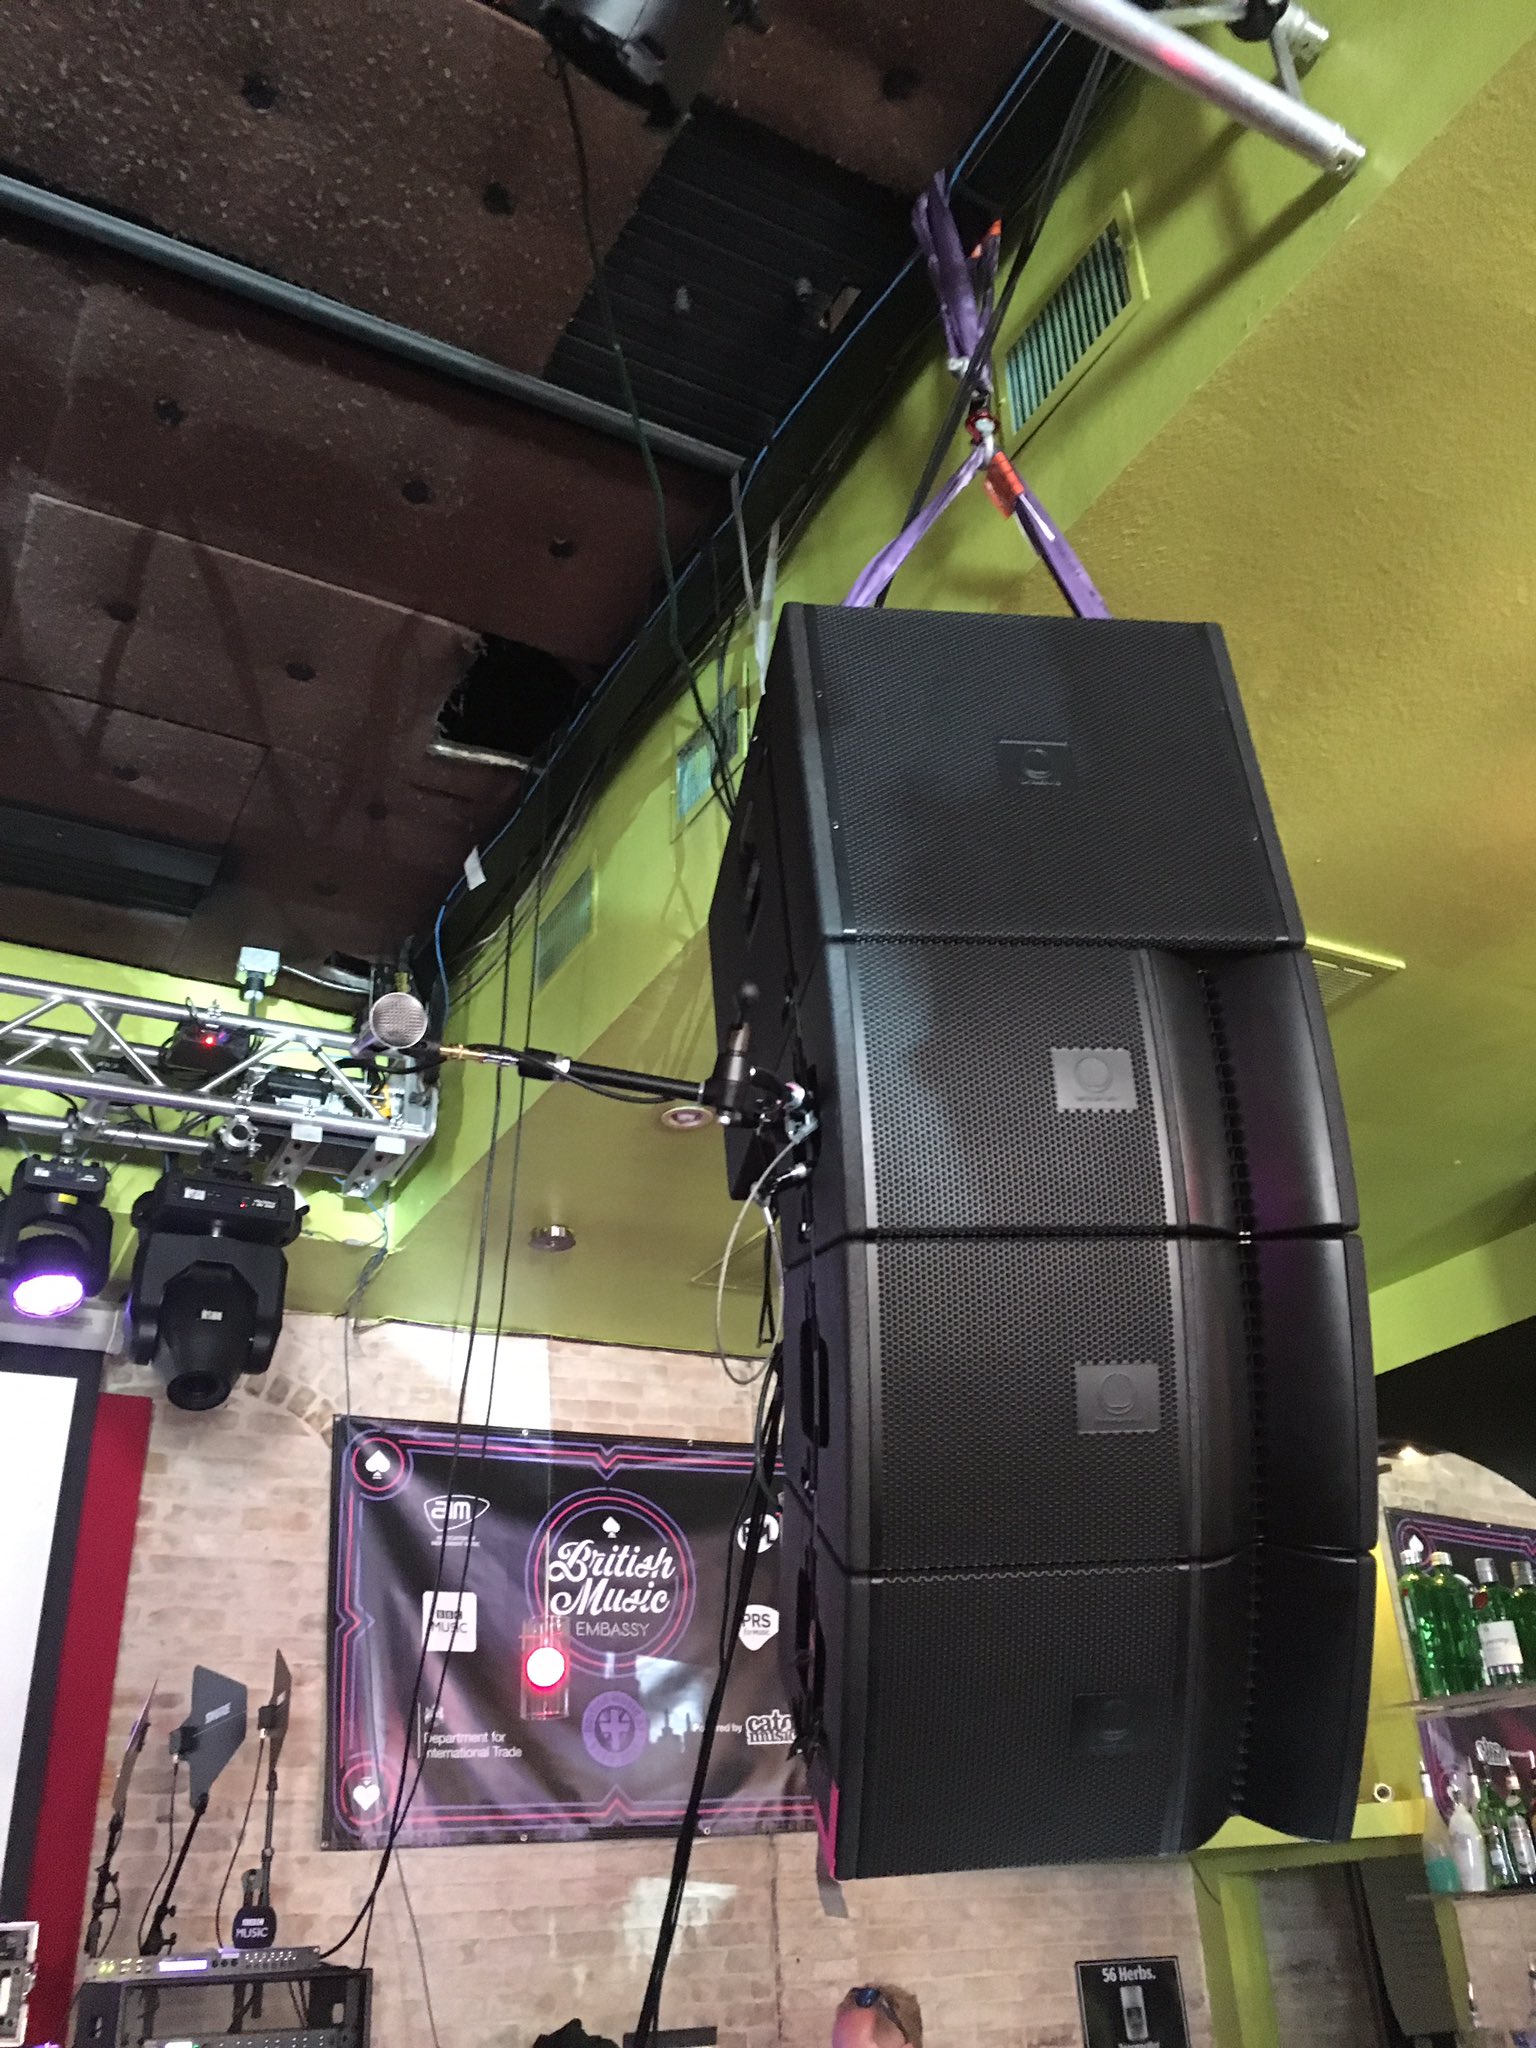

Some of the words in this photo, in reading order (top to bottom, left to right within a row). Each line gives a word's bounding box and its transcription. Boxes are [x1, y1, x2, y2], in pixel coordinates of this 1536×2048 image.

[549, 1539, 676, 1582] British
[550, 1577, 670, 1616] Music
[430, 1622, 468, 1633] MUSC
[743, 1613, 771, 1628] PRS
[576, 1621, 650, 1637] EMBASSY
[693, 1724, 730, 1733] Pored
[732, 1723, 743, 1733] by
[491, 1731, 506, 1742] for
[426, 1746, 490, 1758] nternational
[492, 1745, 522, 1757] Trade
[236, 1927, 268, 1938] MUSIC
[1102, 1967, 1117, 1982] 56
[1118, 1965, 1156, 1981] Herbs.
